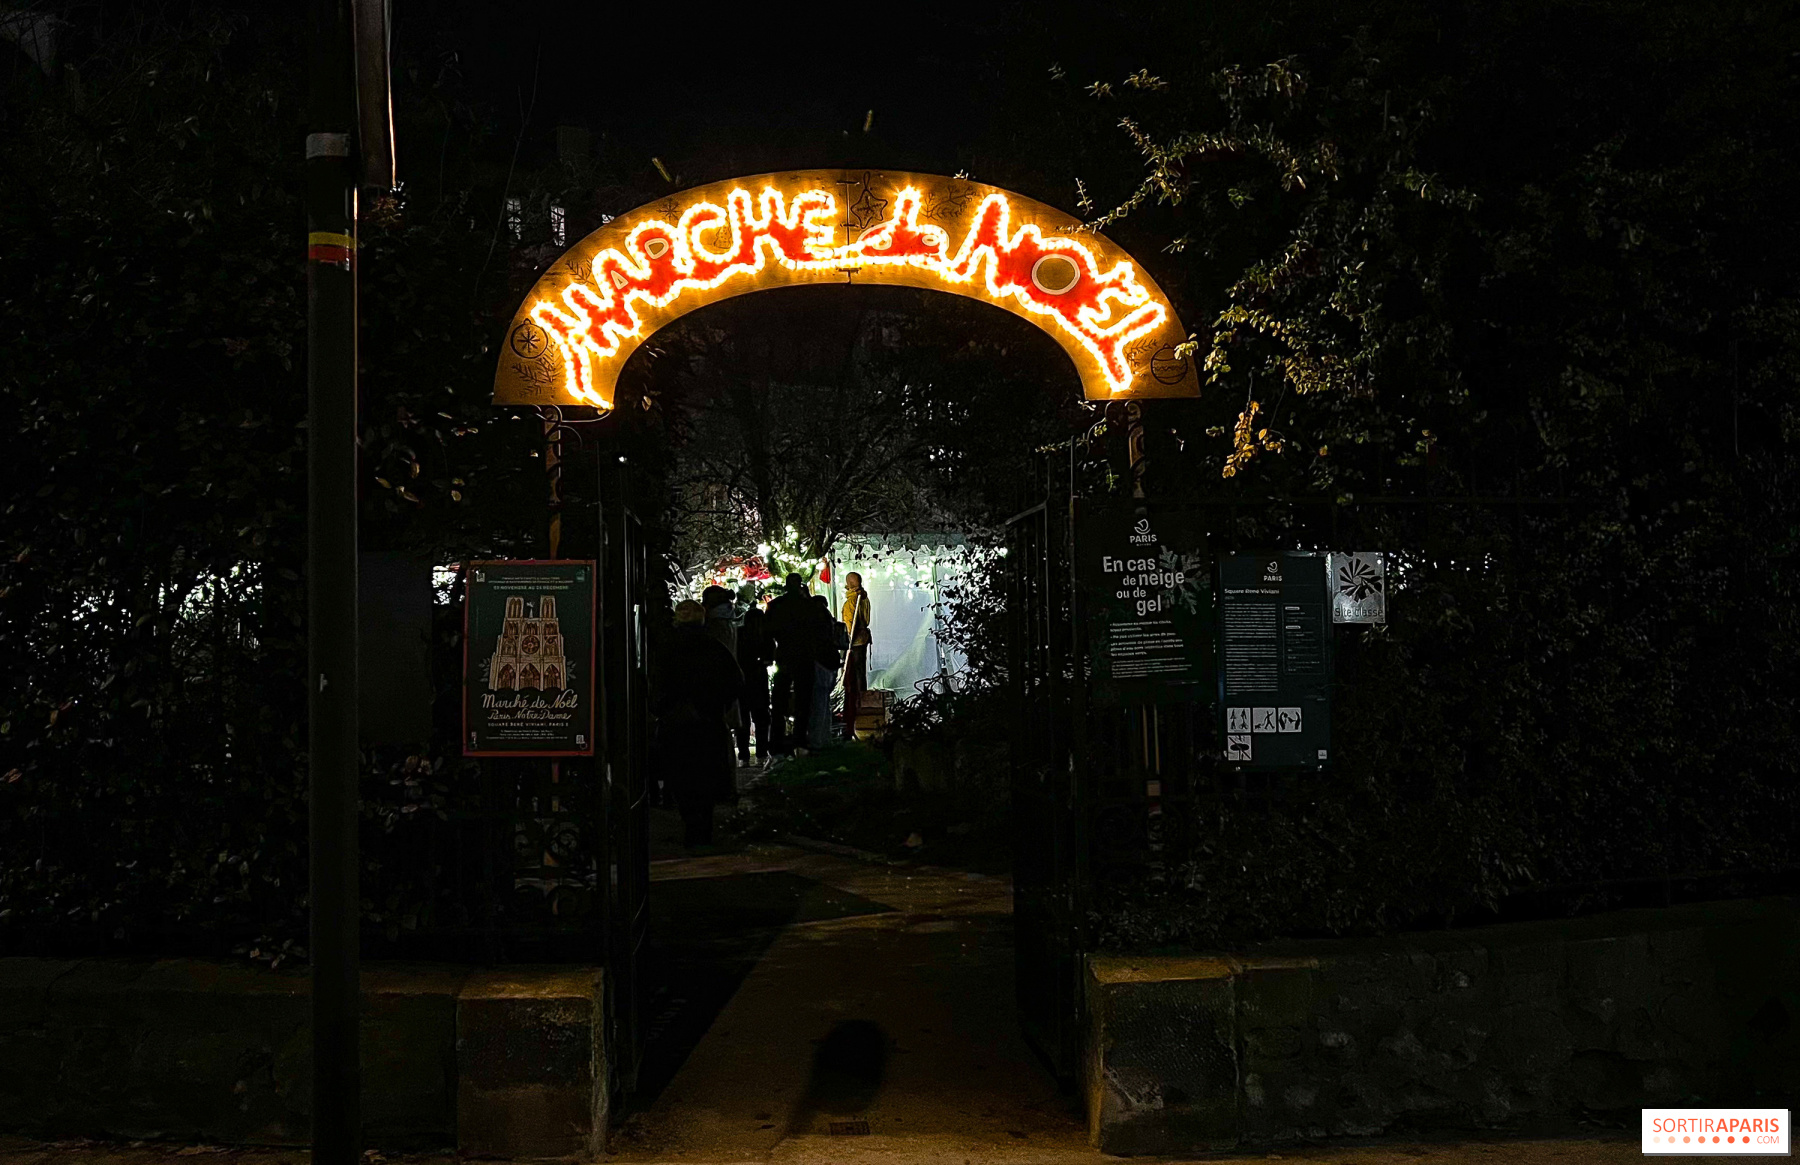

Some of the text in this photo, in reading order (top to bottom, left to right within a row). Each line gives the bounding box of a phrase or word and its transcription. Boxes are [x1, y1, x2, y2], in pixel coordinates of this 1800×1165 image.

[1129, 534, 1157, 543] PARIS
[1102, 556, 1156, 573] En cas
[1122, 569, 1185, 589] de neige
[1116, 587, 1146, 598] ou de
[1136, 594, 1162, 617] gel
[480, 689, 579, 709] Marché de Noël
